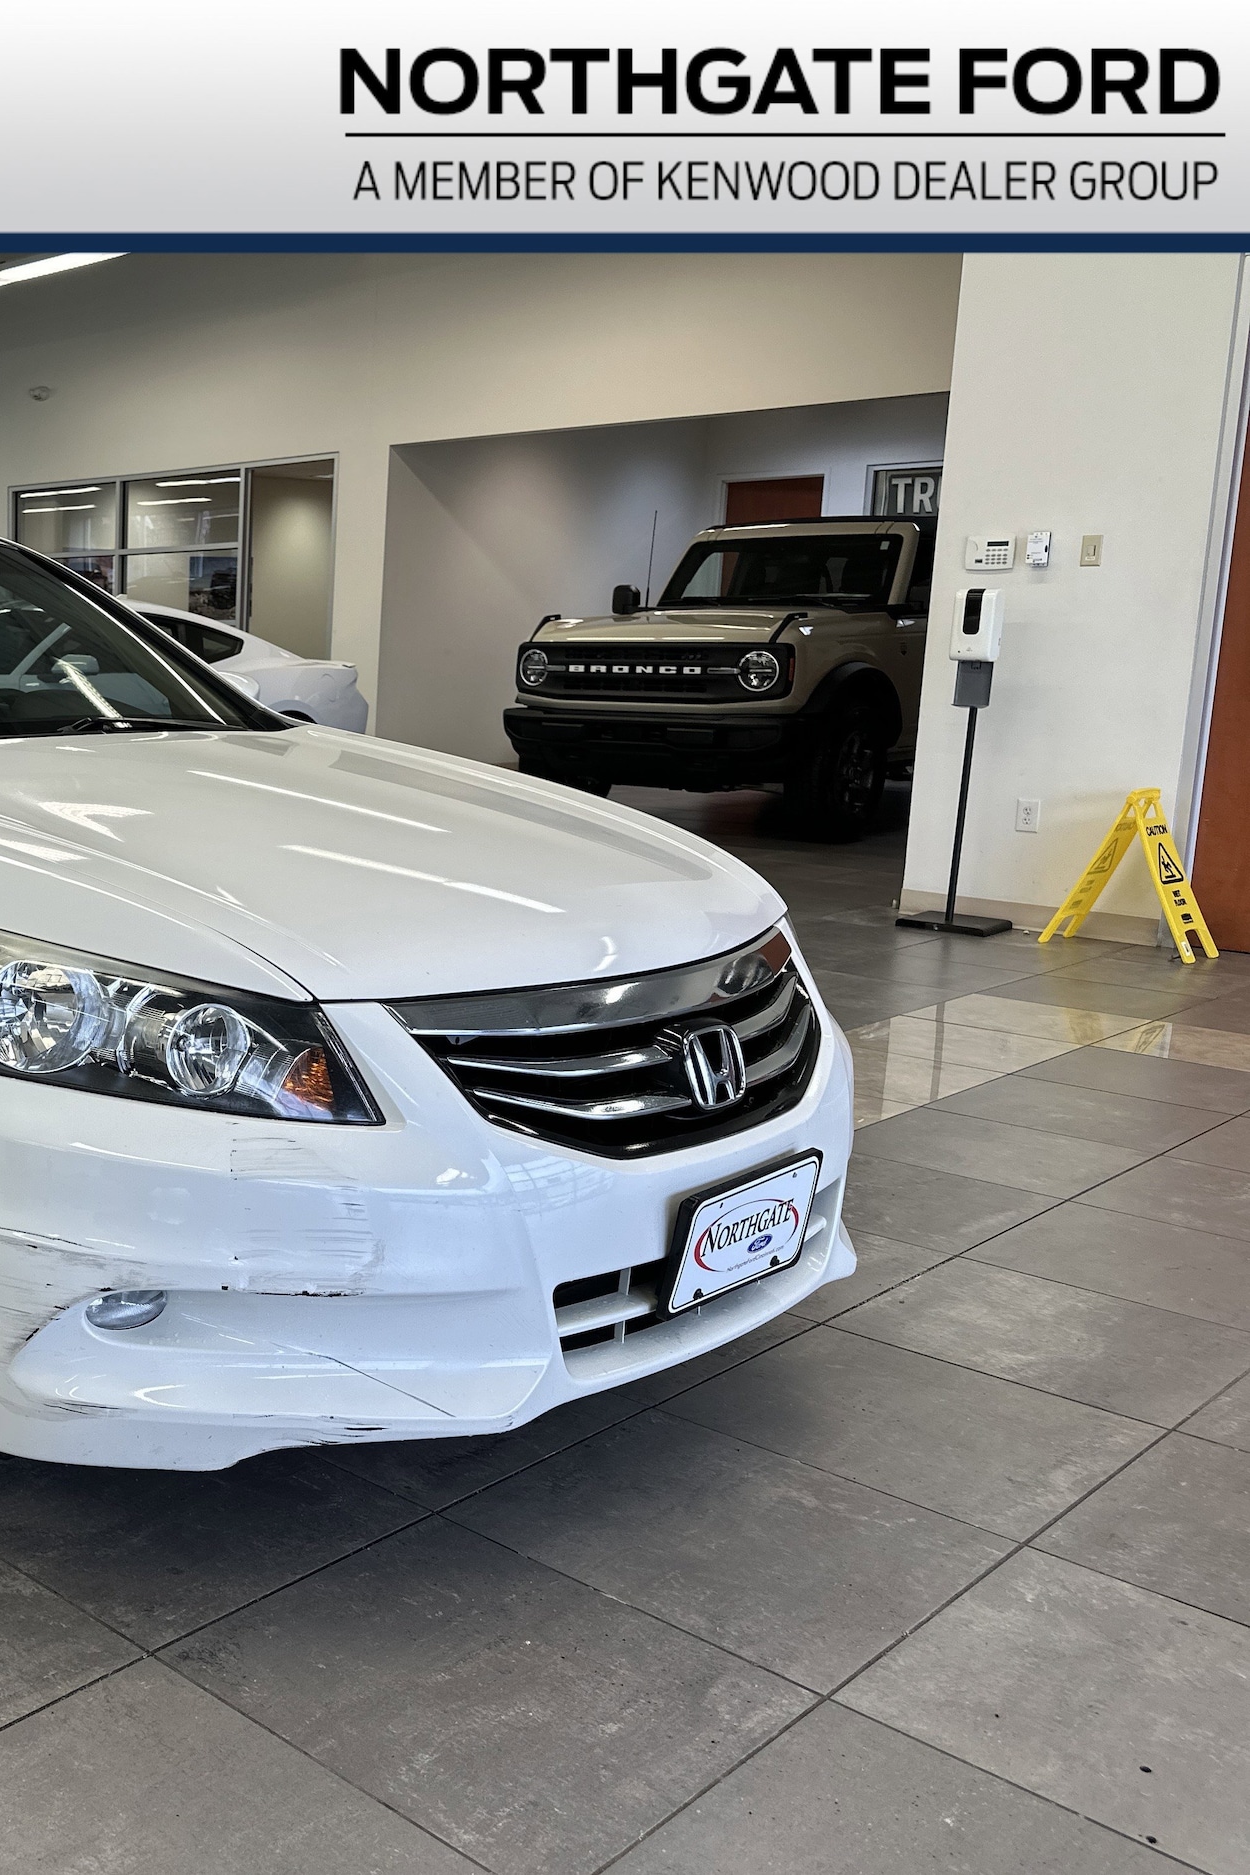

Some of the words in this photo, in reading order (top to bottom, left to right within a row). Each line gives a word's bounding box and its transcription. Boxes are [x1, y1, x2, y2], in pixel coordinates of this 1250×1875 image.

[891, 476, 942, 514] TR
[568, 664, 702, 675] BRONCO
[1146, 824, 1168, 836] CAUTION
[701, 1198, 794, 1258] NORTHGATE
